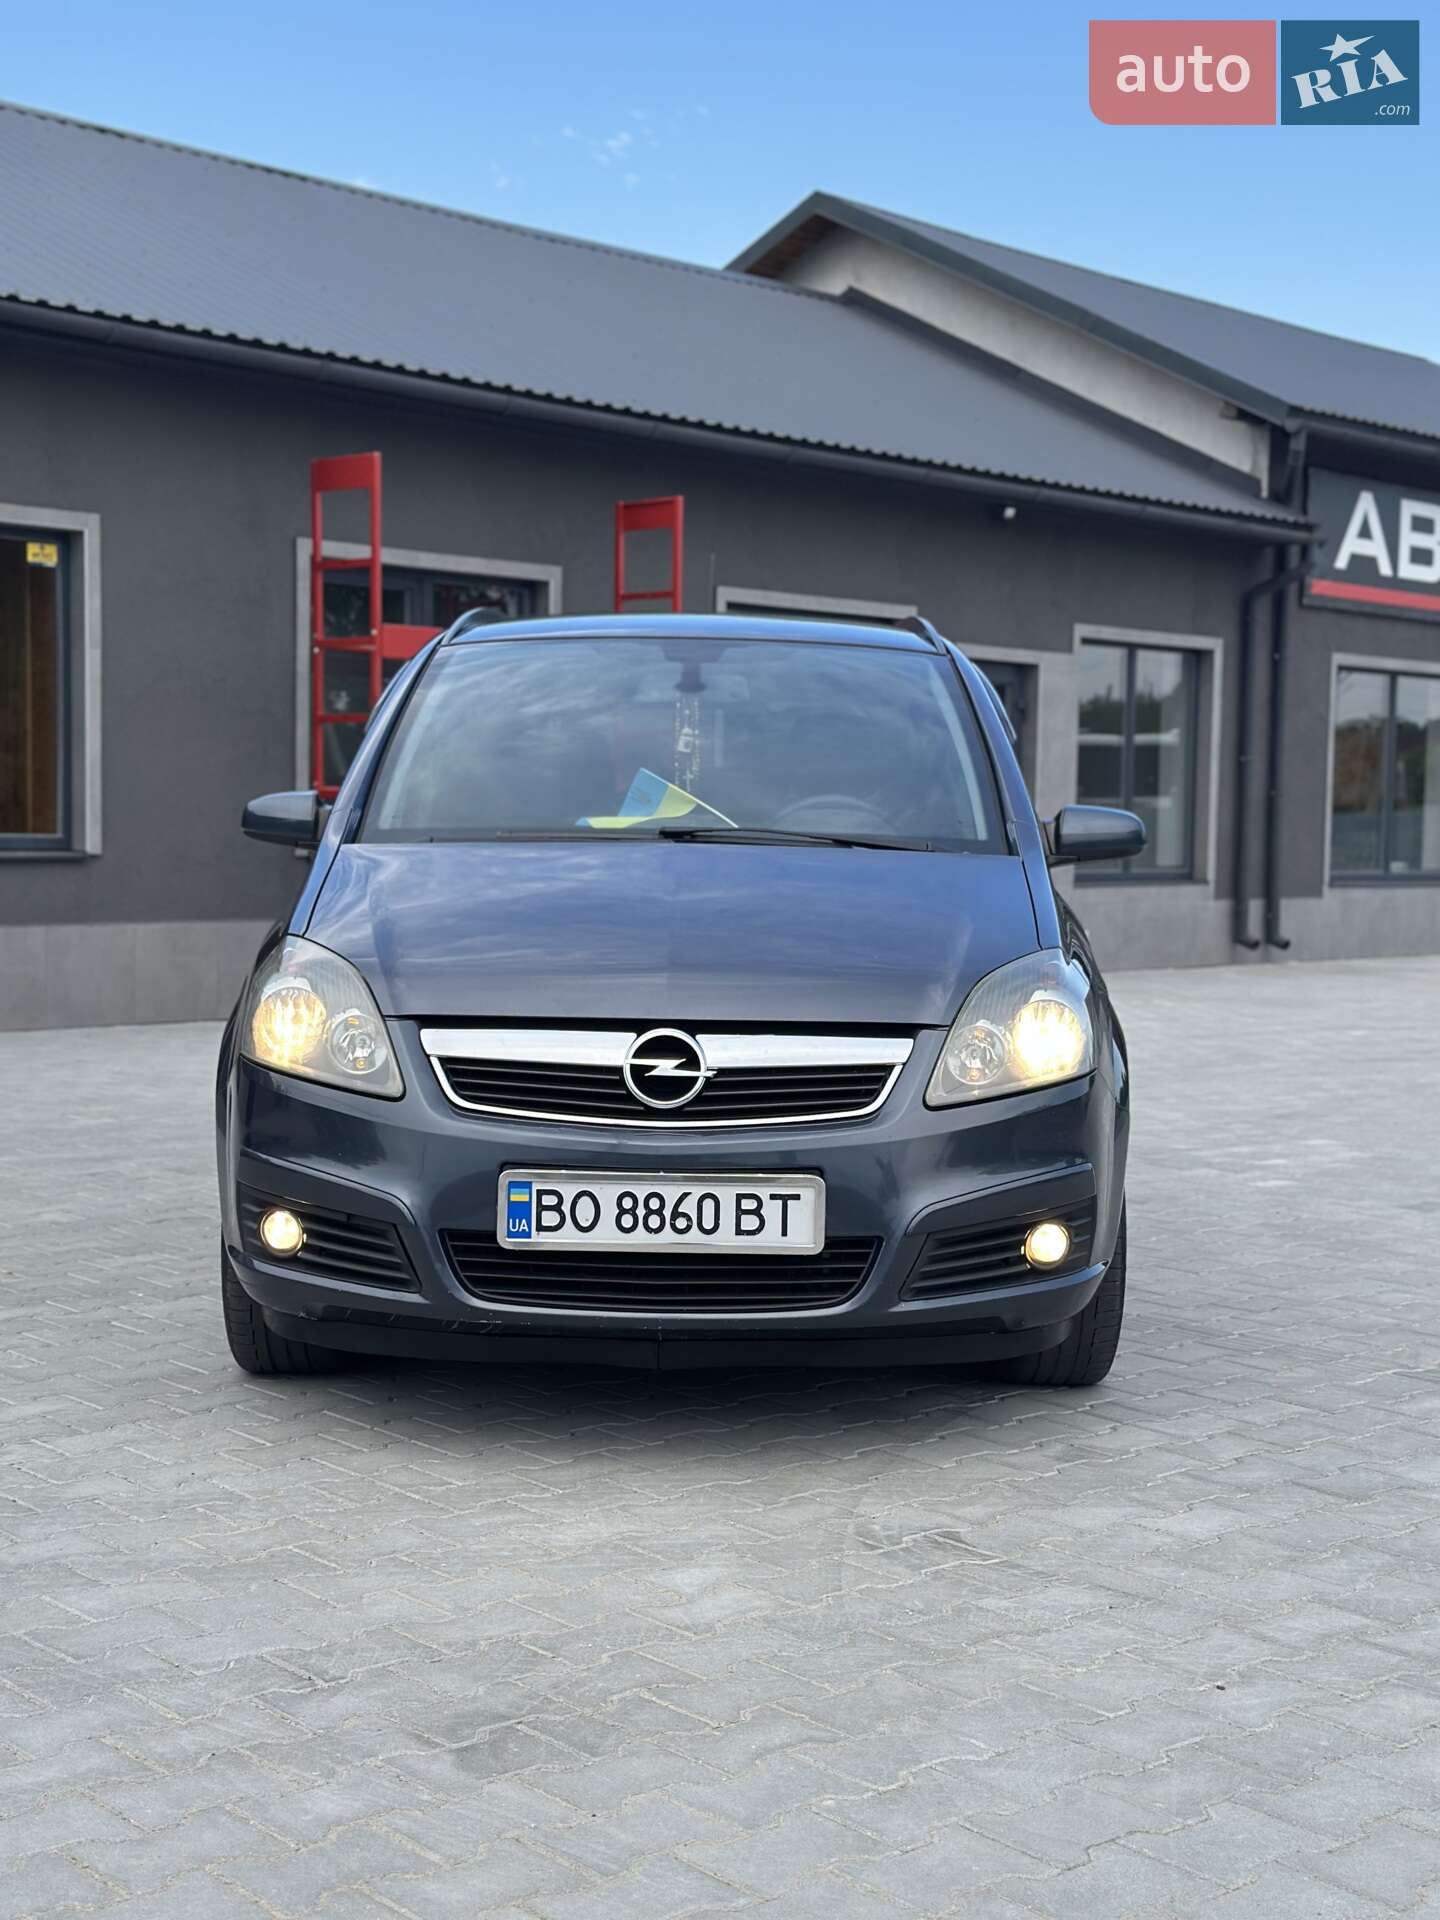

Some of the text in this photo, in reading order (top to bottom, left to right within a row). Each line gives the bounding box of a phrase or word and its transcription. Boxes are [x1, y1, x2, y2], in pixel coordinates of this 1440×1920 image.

[509, 1219, 530, 1233] UA
[535, 1188, 801, 1237] BO 8860 BT
